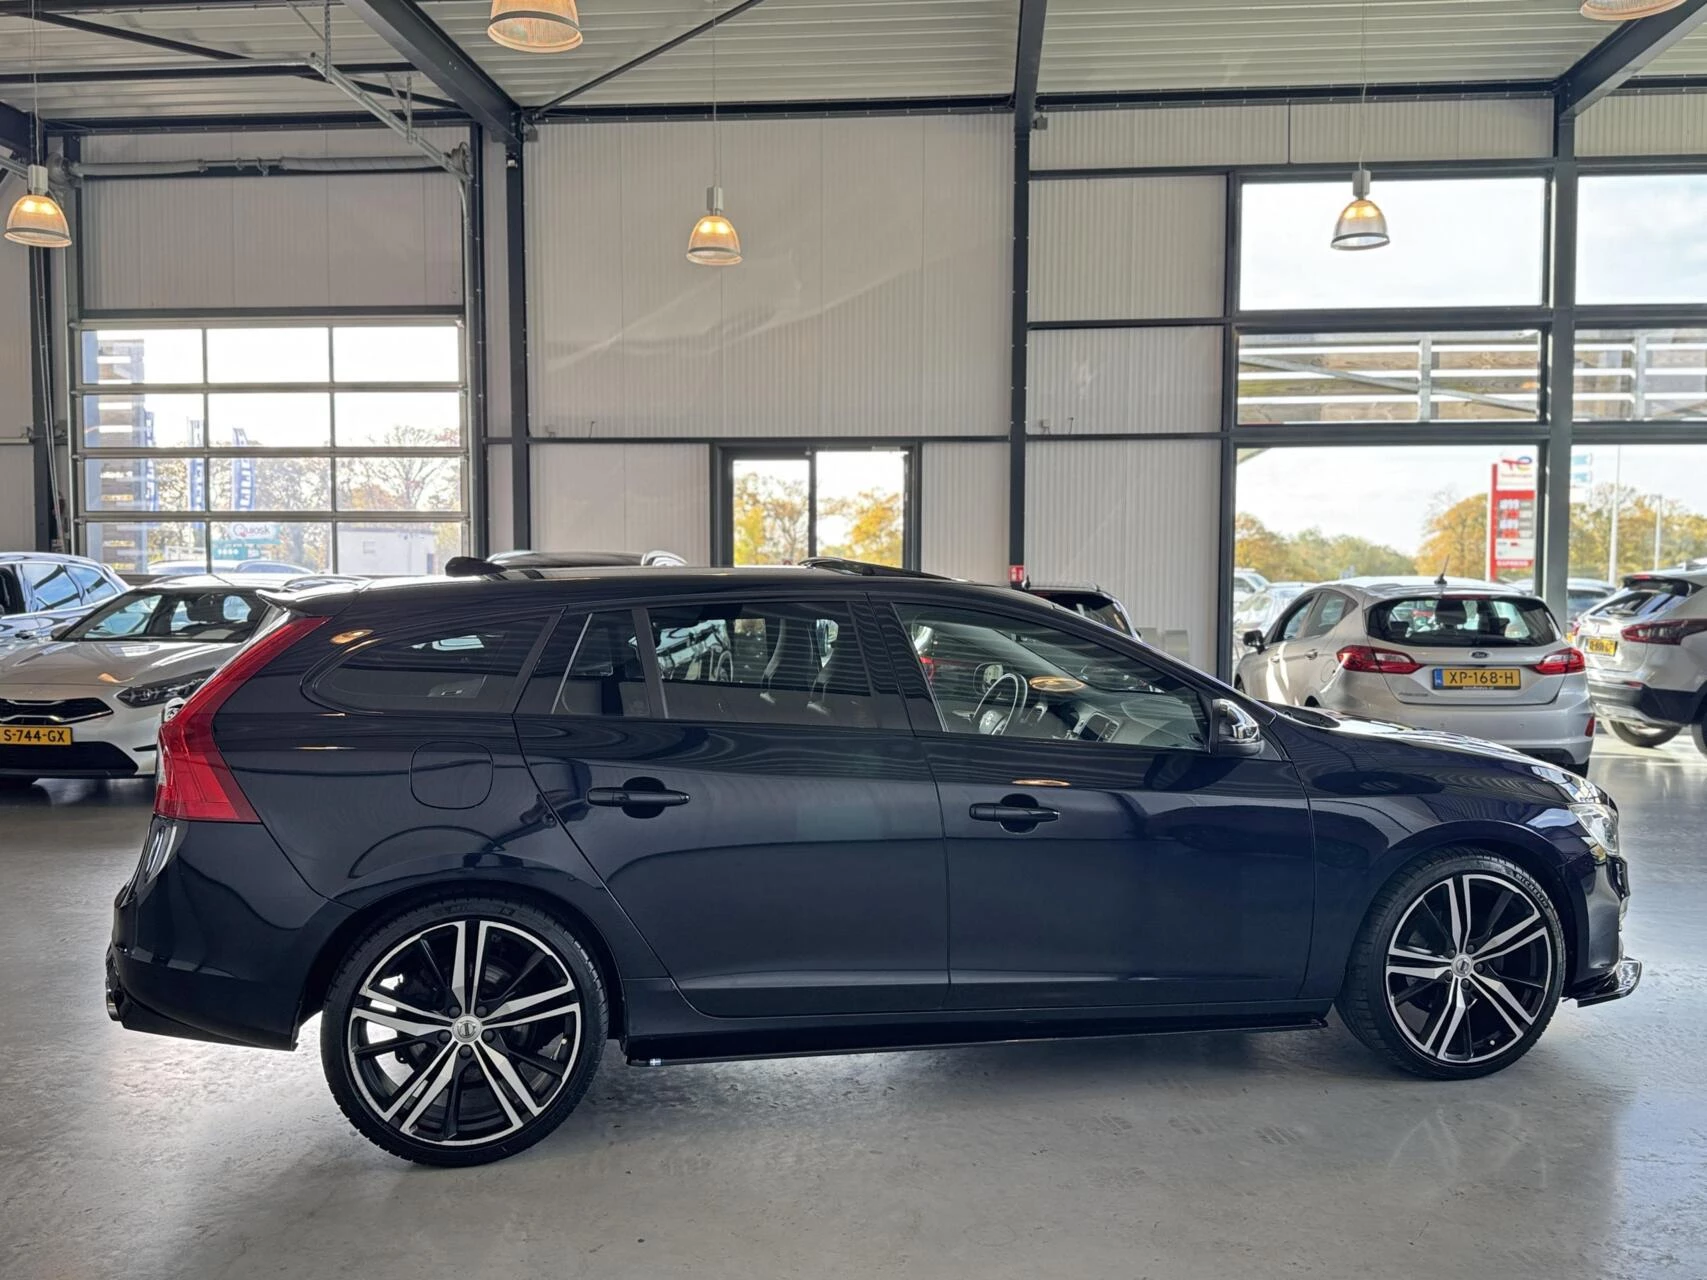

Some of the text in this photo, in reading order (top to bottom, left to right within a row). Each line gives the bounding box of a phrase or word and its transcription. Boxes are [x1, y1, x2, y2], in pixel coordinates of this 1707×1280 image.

[1449, 671, 1514, 684] XP-168-H
[4, 729, 65, 742] S-744-GX
[1515, 873, 1548, 908] MICHELIN
